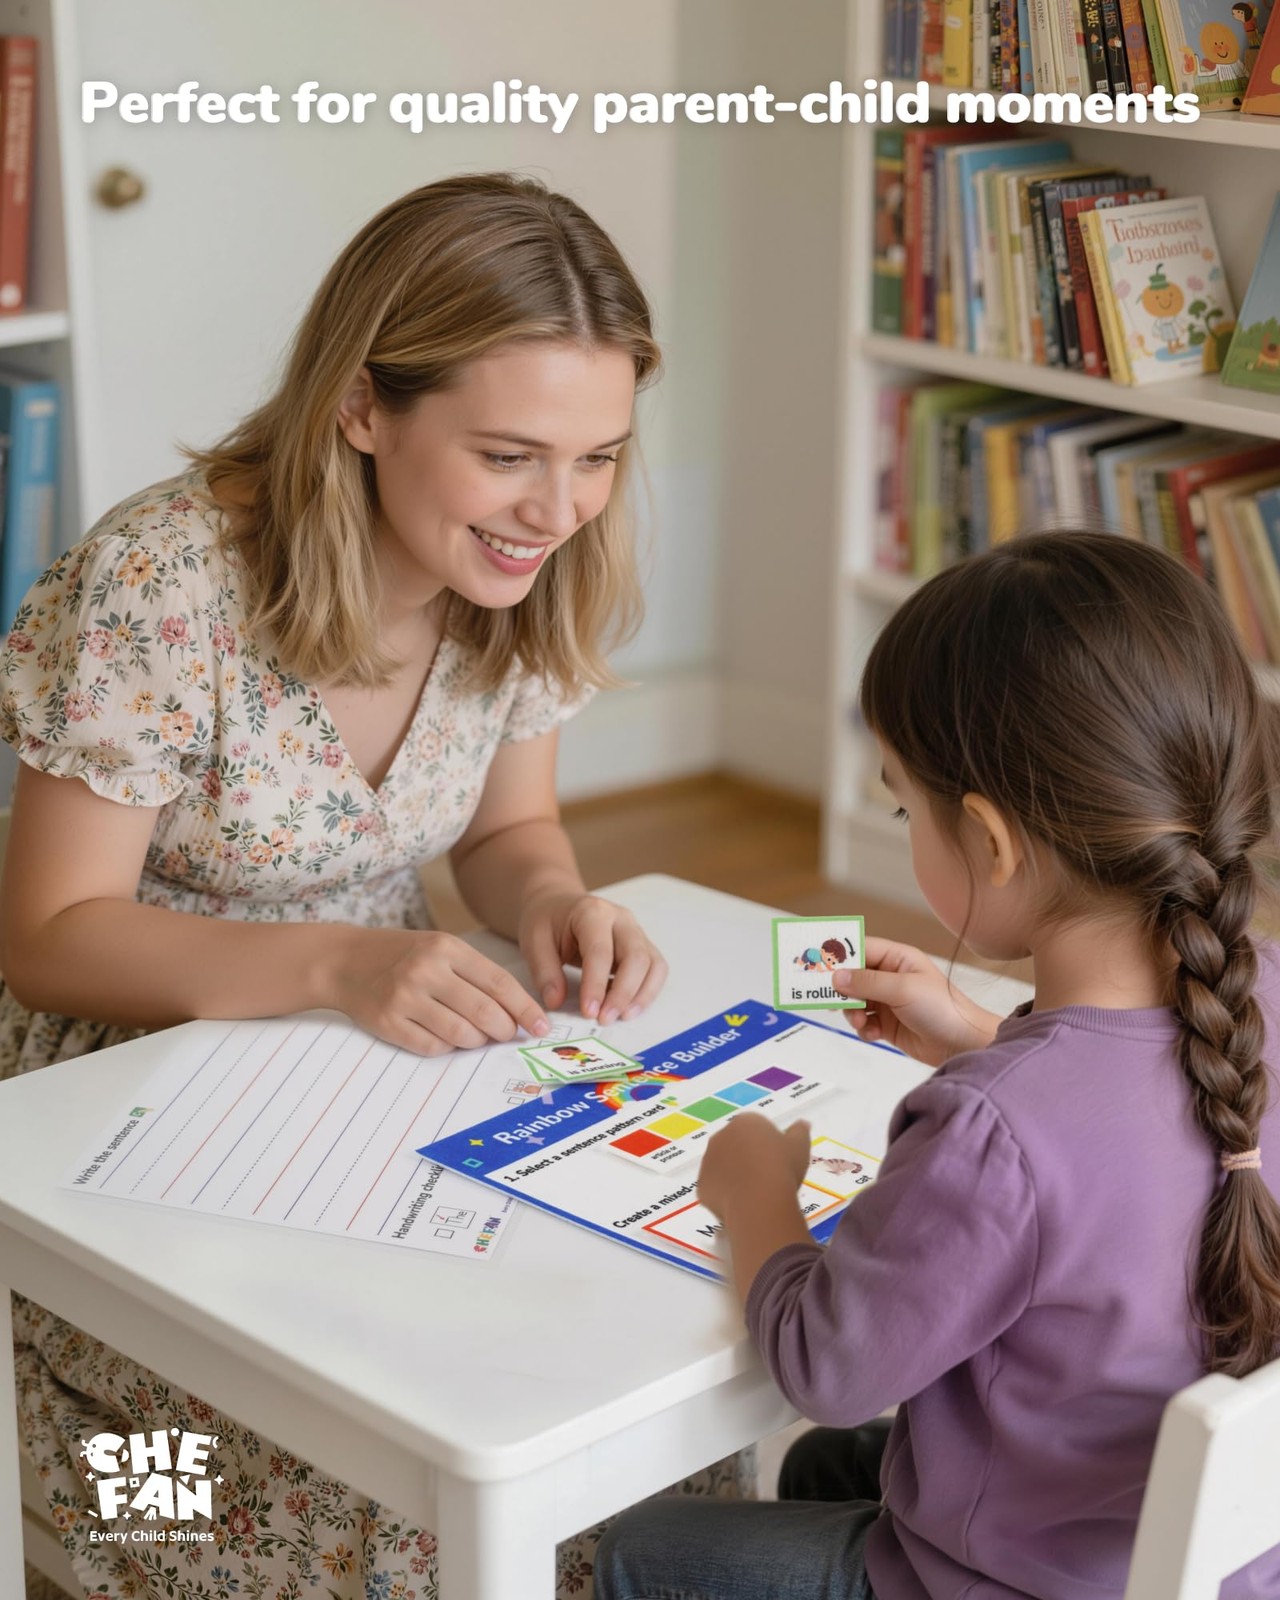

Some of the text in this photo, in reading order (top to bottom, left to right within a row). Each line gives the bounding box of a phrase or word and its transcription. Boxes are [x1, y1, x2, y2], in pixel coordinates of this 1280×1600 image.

[791, 987, 803, 1000] is
[581, 1061, 627, 1073] running
[492, 1101, 591, 1145] Rainbow
[584, 1060, 679, 1103] Sentence
[670, 1028, 742, 1063] Builder
[72, 1119, 140, 1185] Write the sentence
[516, 1158, 555, 1177] Select
[551, 1154, 562, 1162] a
[560, 1132, 607, 1158] sentence
[608, 1115, 645, 1136] pattern
[642, 1104, 667, 1118] card
[855, 1174, 874, 1185] cat
[391, 1163, 445, 1240] Handwriting checkli
[800, 1202, 821, 1215] ean
[612, 1207, 652, 1229] Create
[651, 1202, 661, 1211] a
